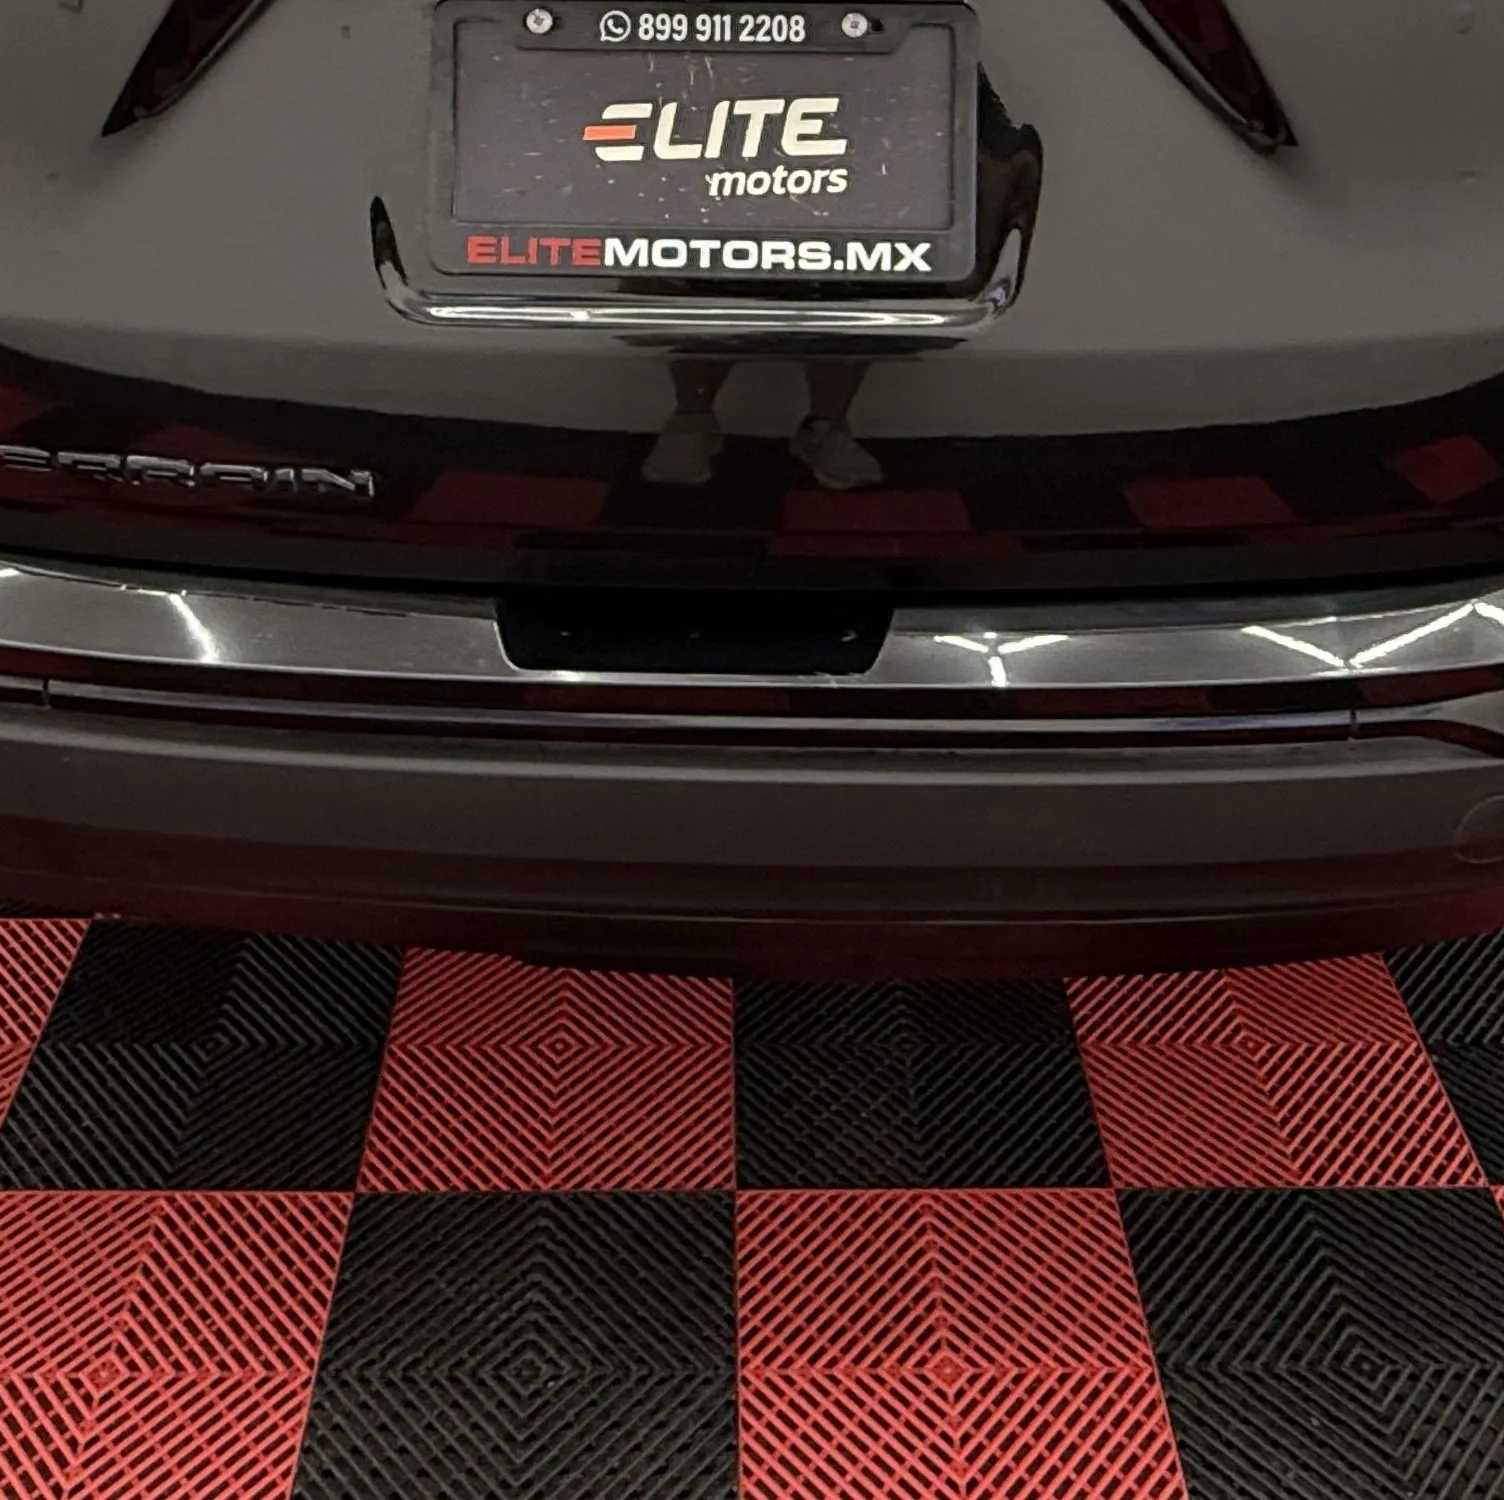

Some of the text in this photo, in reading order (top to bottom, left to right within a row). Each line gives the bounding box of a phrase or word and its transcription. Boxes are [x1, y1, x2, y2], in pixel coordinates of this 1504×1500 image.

[638, 13, 806, 43] 899 911 2208
[583, 97, 847, 161] ELITE
[707, 164, 848, 197] motors
[466, 235, 932, 273] ELITEMOTORS.MX
